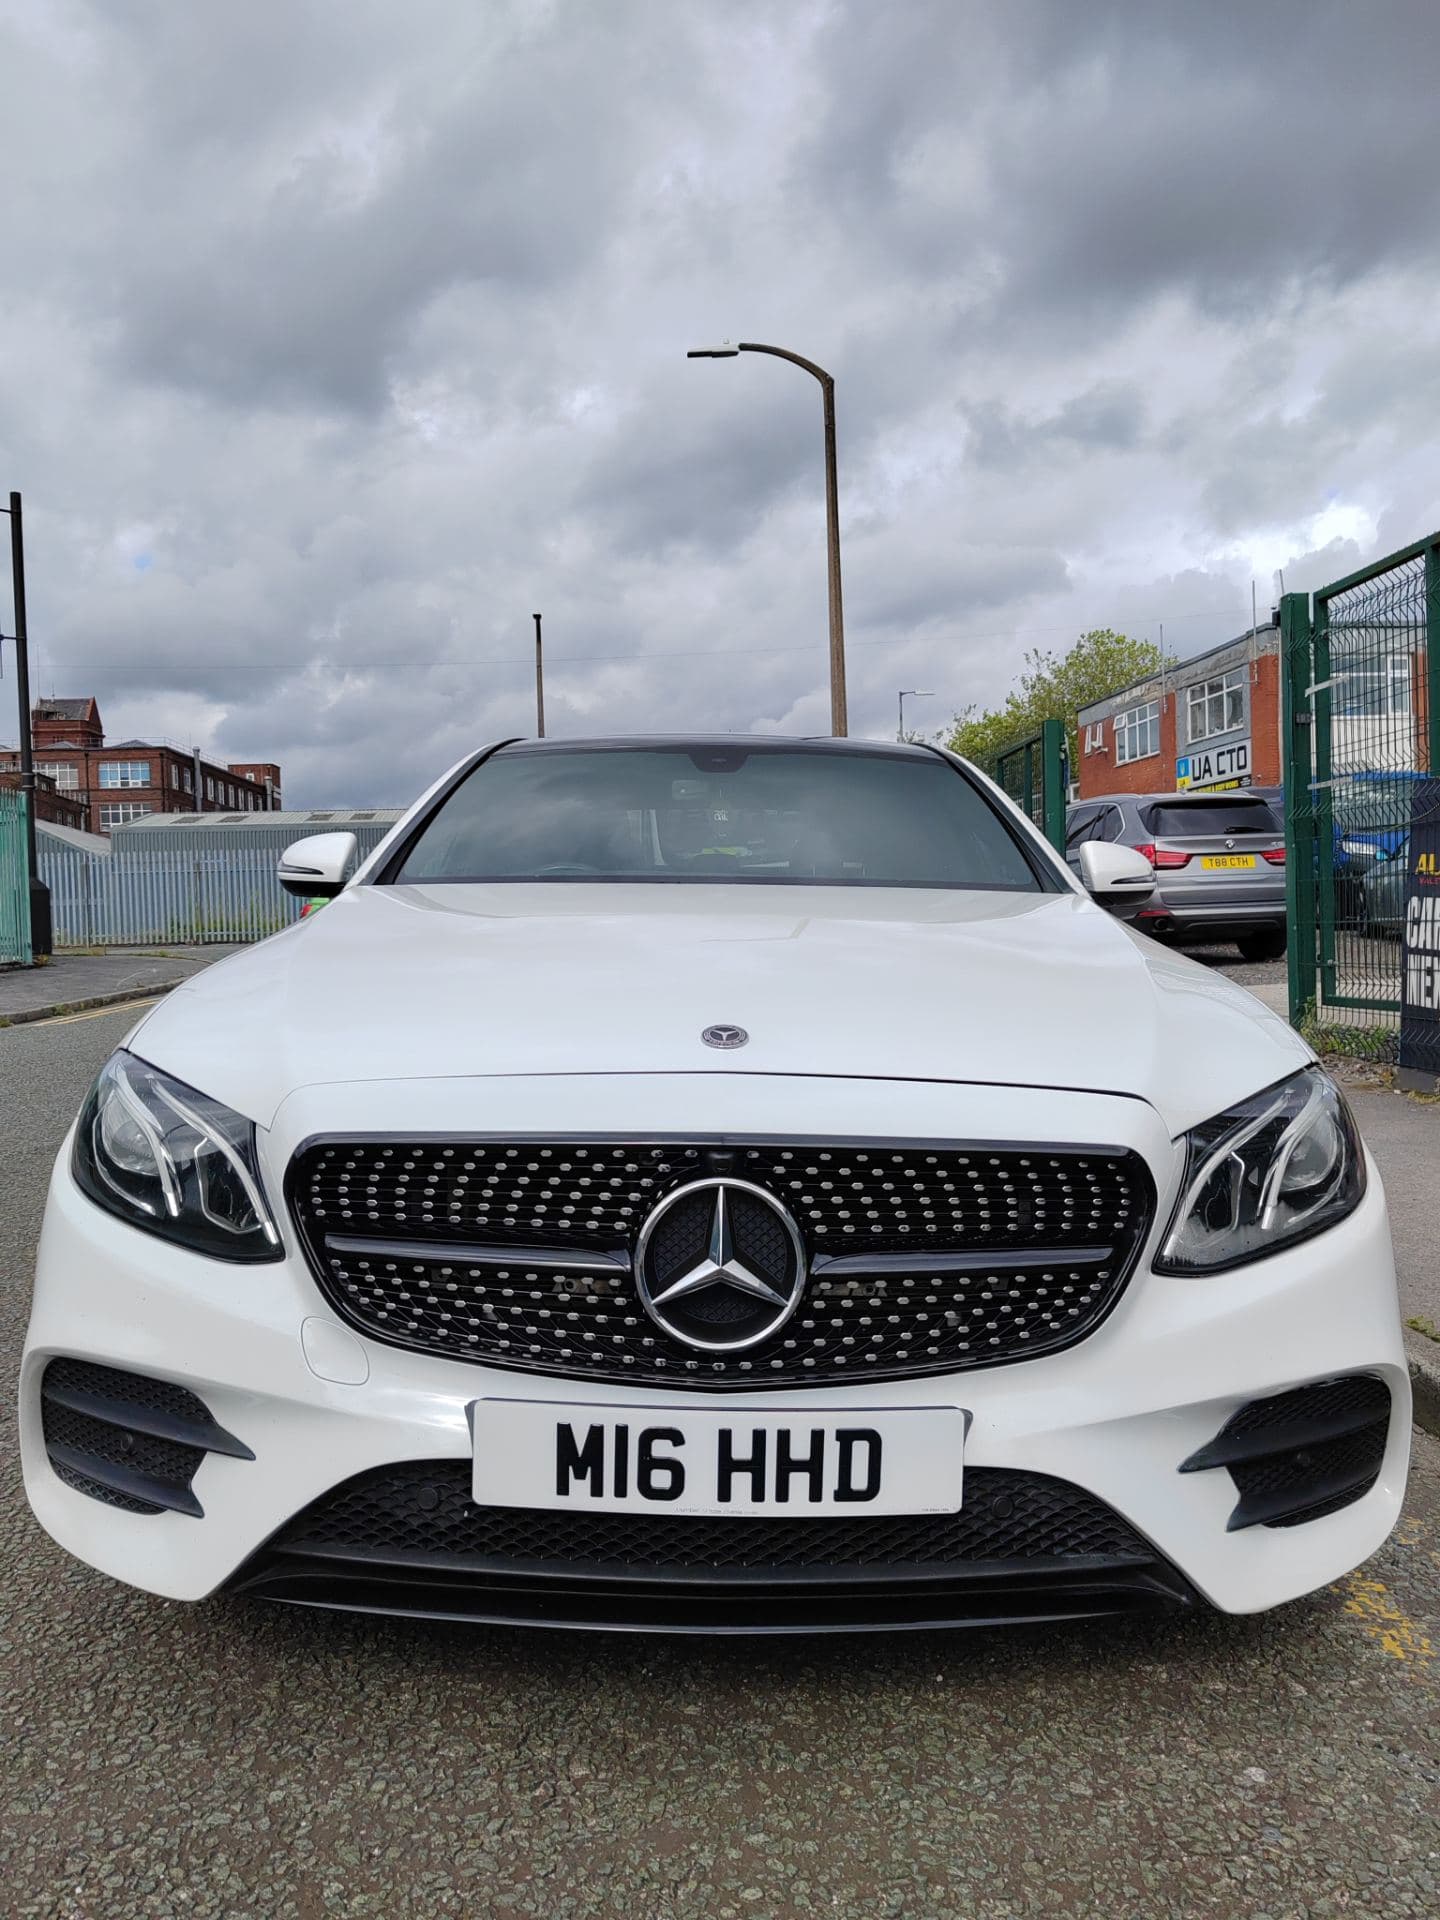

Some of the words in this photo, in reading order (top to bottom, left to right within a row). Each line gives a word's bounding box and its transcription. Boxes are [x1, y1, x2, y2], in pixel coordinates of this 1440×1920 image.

[1217, 745, 1248, 775] CTO
[556, 1422, 686, 1501] M16
[717, 1427, 883, 1503] HHD
